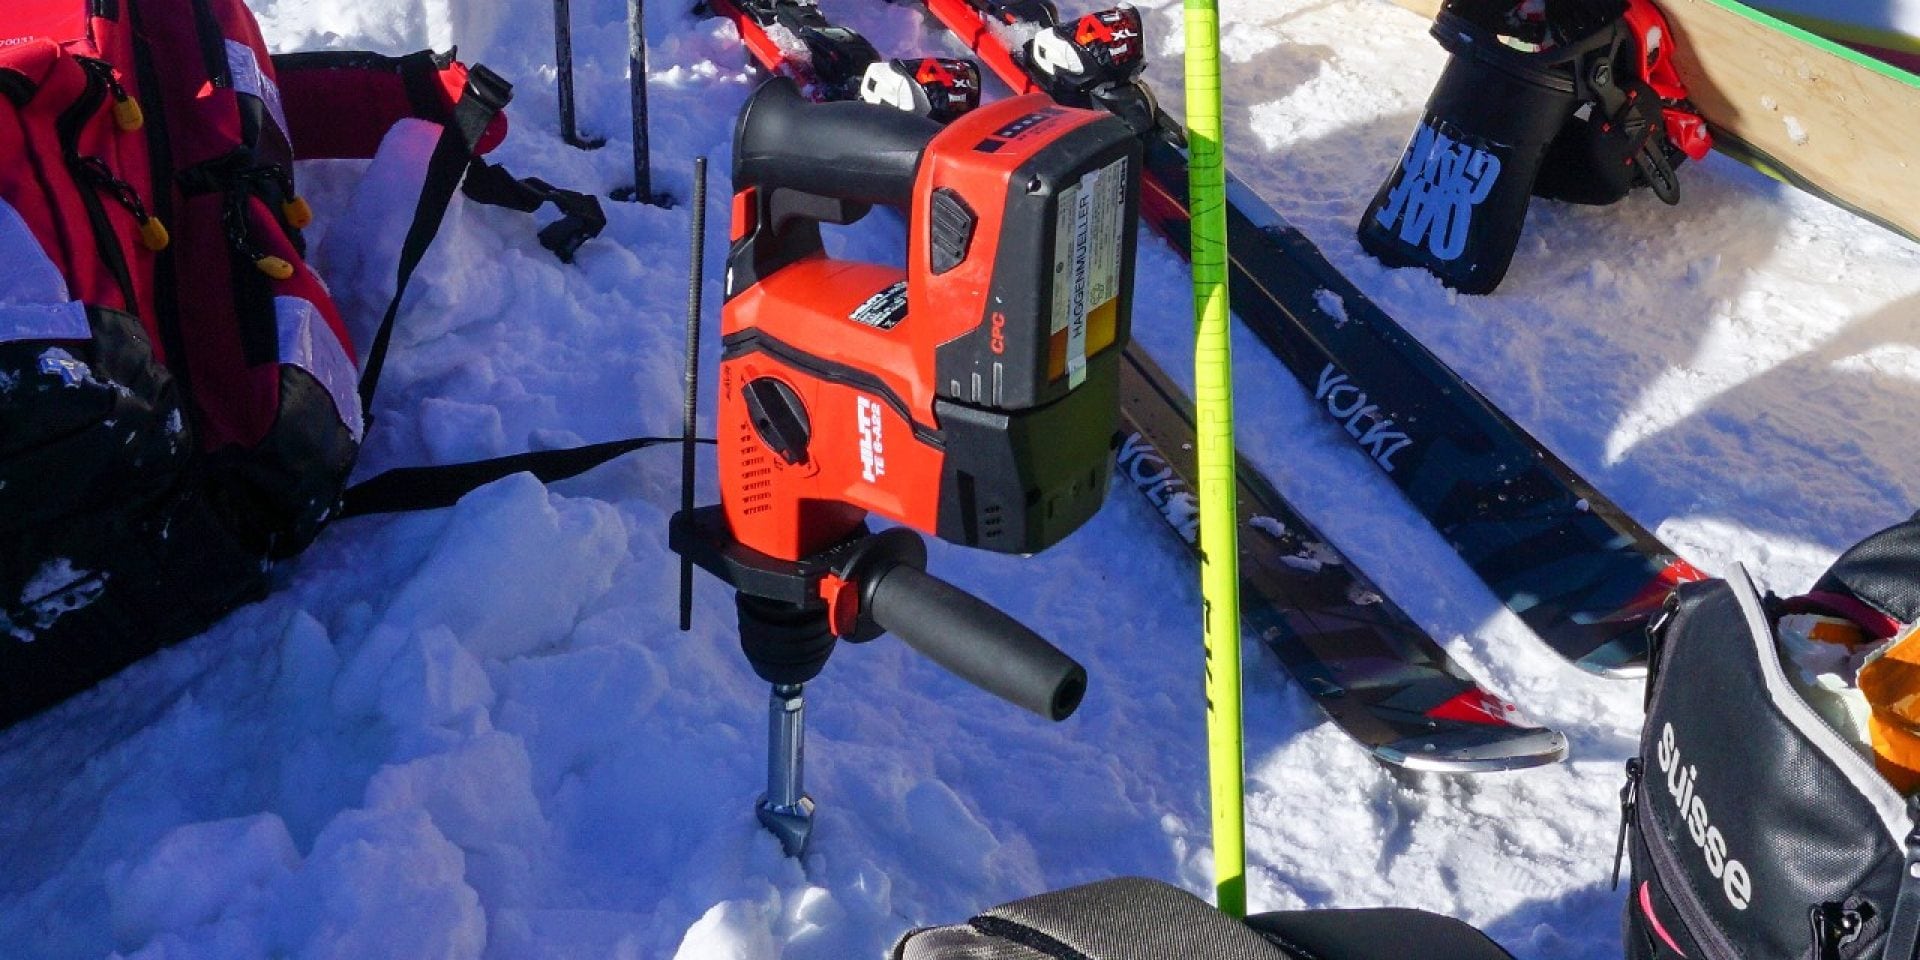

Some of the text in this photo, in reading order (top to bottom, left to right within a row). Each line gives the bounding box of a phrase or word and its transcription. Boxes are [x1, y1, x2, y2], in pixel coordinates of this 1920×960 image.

[1073, 193, 1090, 339] HAGGENMUELLER
[991, 311, 1005, 355] CPC
[857, 395, 876, 483] HILTI
[874, 454, 885, 476] TE
[1657, 722, 1752, 910] suisse
